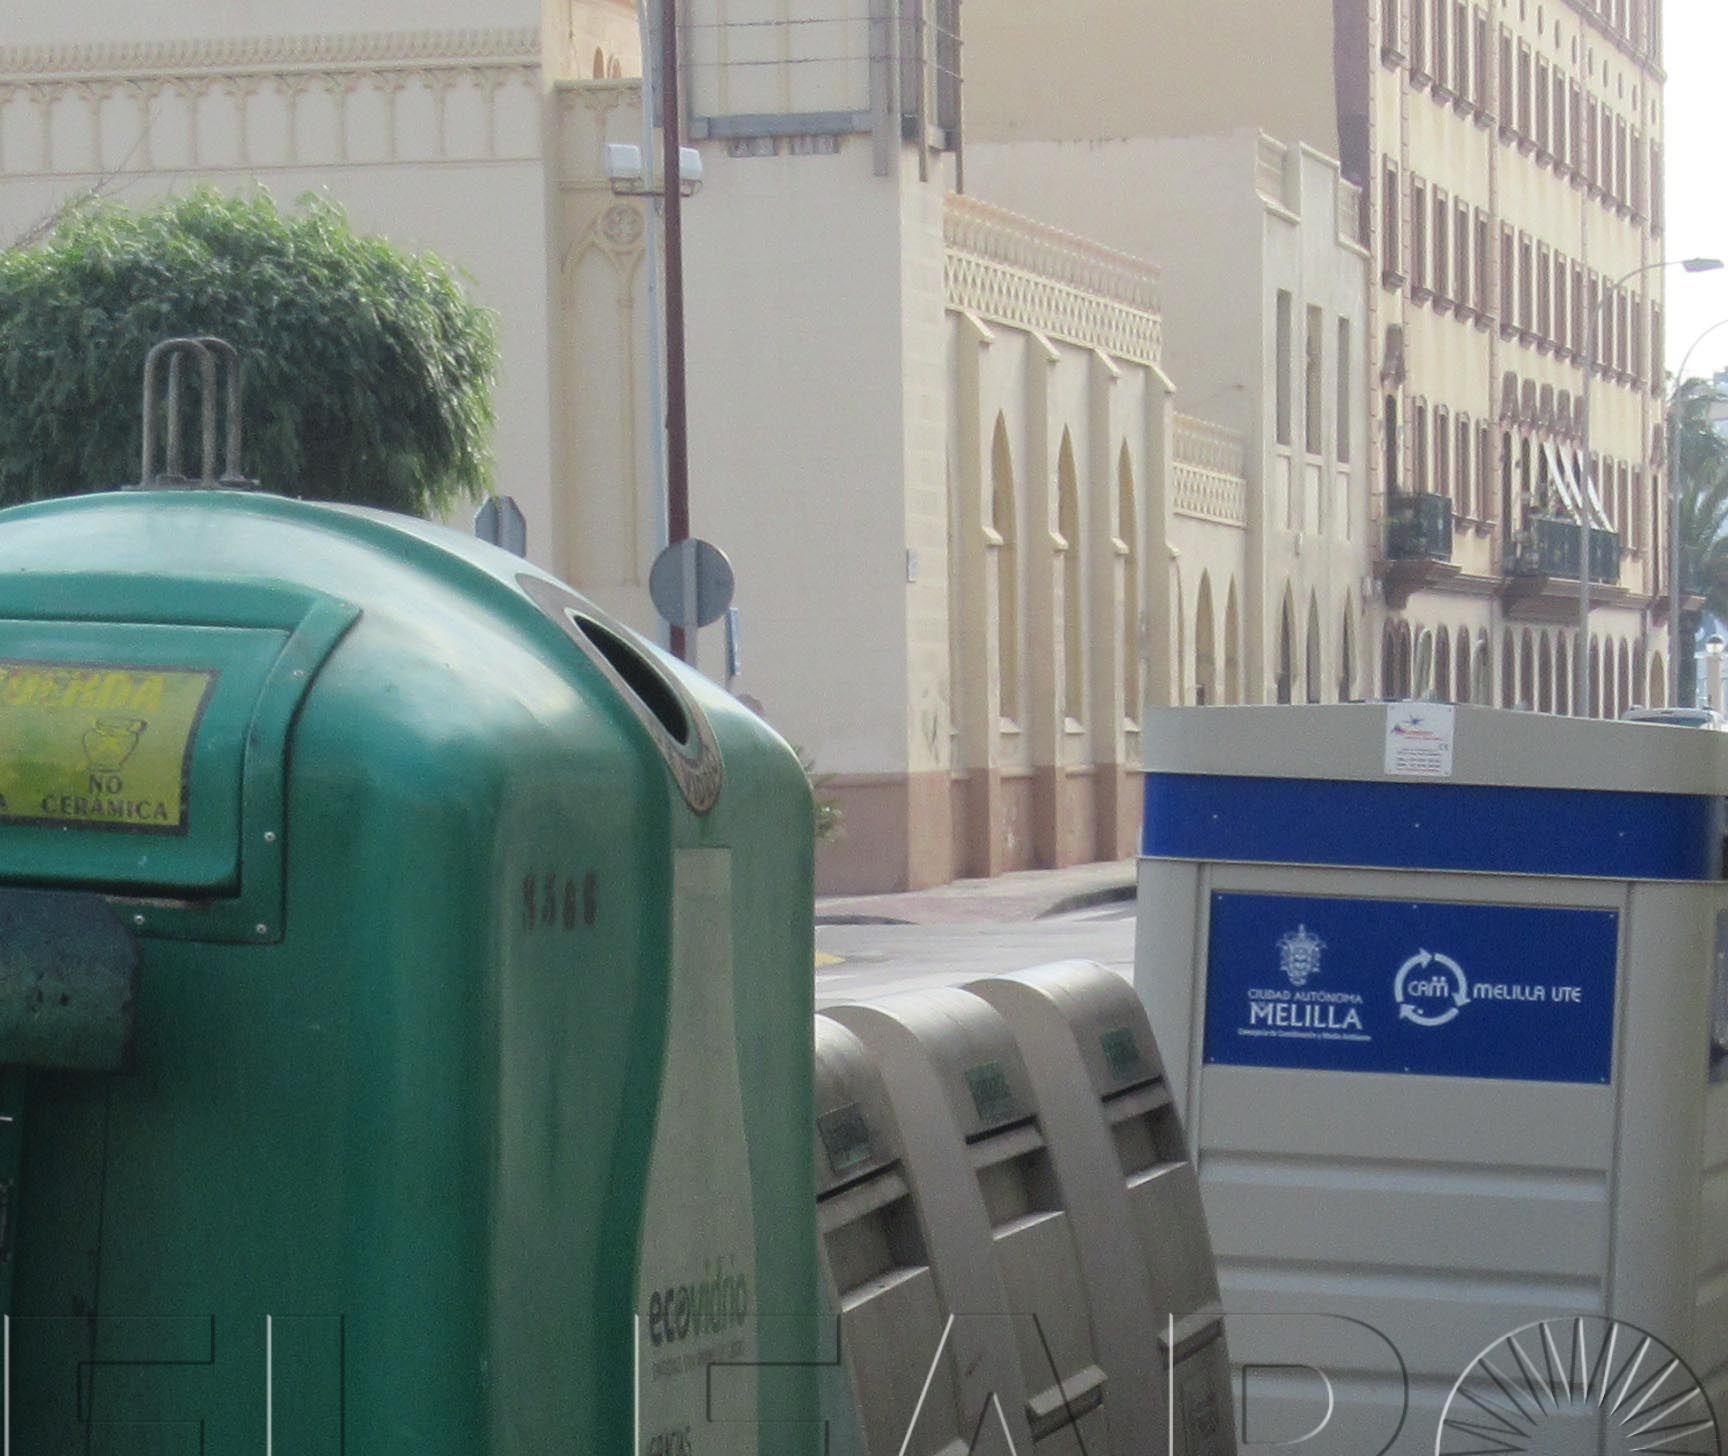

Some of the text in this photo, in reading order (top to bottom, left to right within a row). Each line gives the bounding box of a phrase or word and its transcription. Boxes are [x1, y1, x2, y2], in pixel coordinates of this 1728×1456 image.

[89, 774, 123, 794] NO
[1248, 988, 1291, 1001] CIUDAD
[1473, 983, 1545, 1002] MELILLA
[1551, 986, 1582, 1003] UTE
[1250, 1002, 1363, 1030] MELILLA
